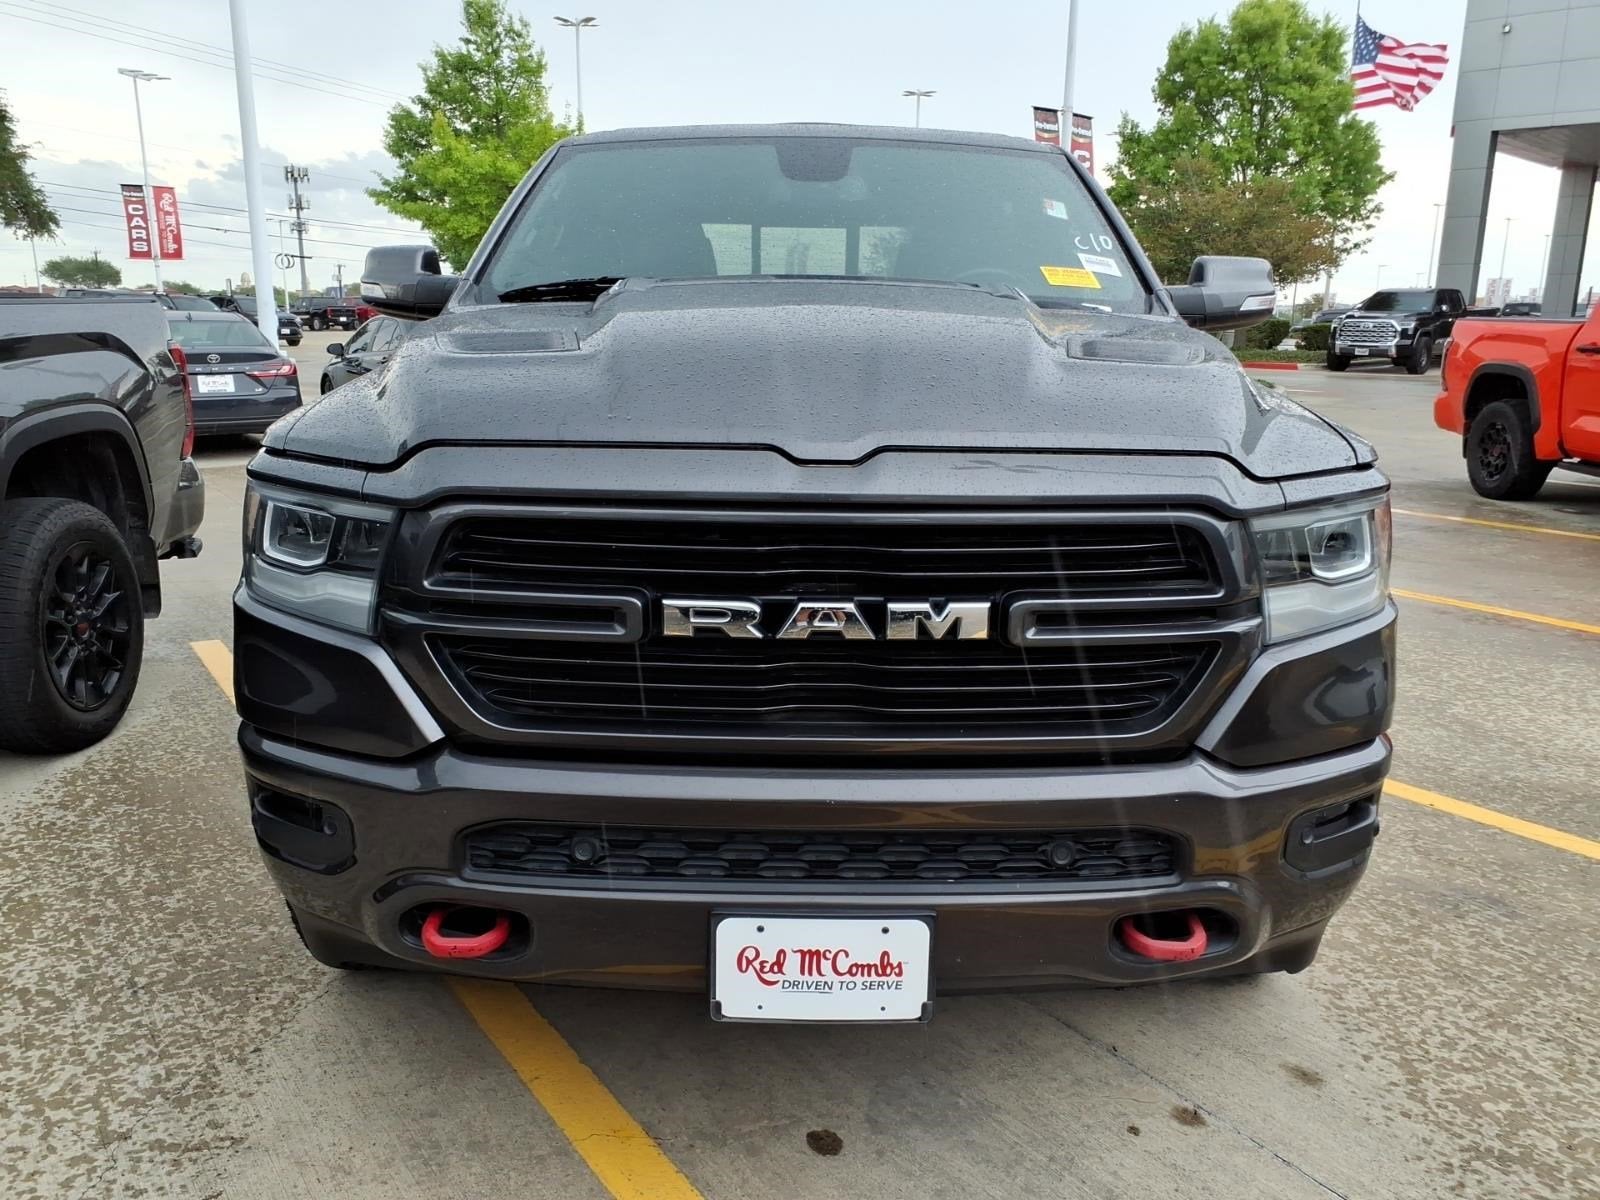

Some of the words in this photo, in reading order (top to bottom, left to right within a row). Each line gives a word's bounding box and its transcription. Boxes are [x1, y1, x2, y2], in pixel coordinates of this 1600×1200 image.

[160, 192, 174, 212] Red
[127, 204, 148, 252] CARS
[660, 597, 993, 641] RAM
[736, 945, 787, 987] Red
[791, 948, 904, 978] McCombs
[781, 980, 834, 991] DRIVEN
[838, 980, 857, 991] TO
[860, 980, 904, 991] SERVE
